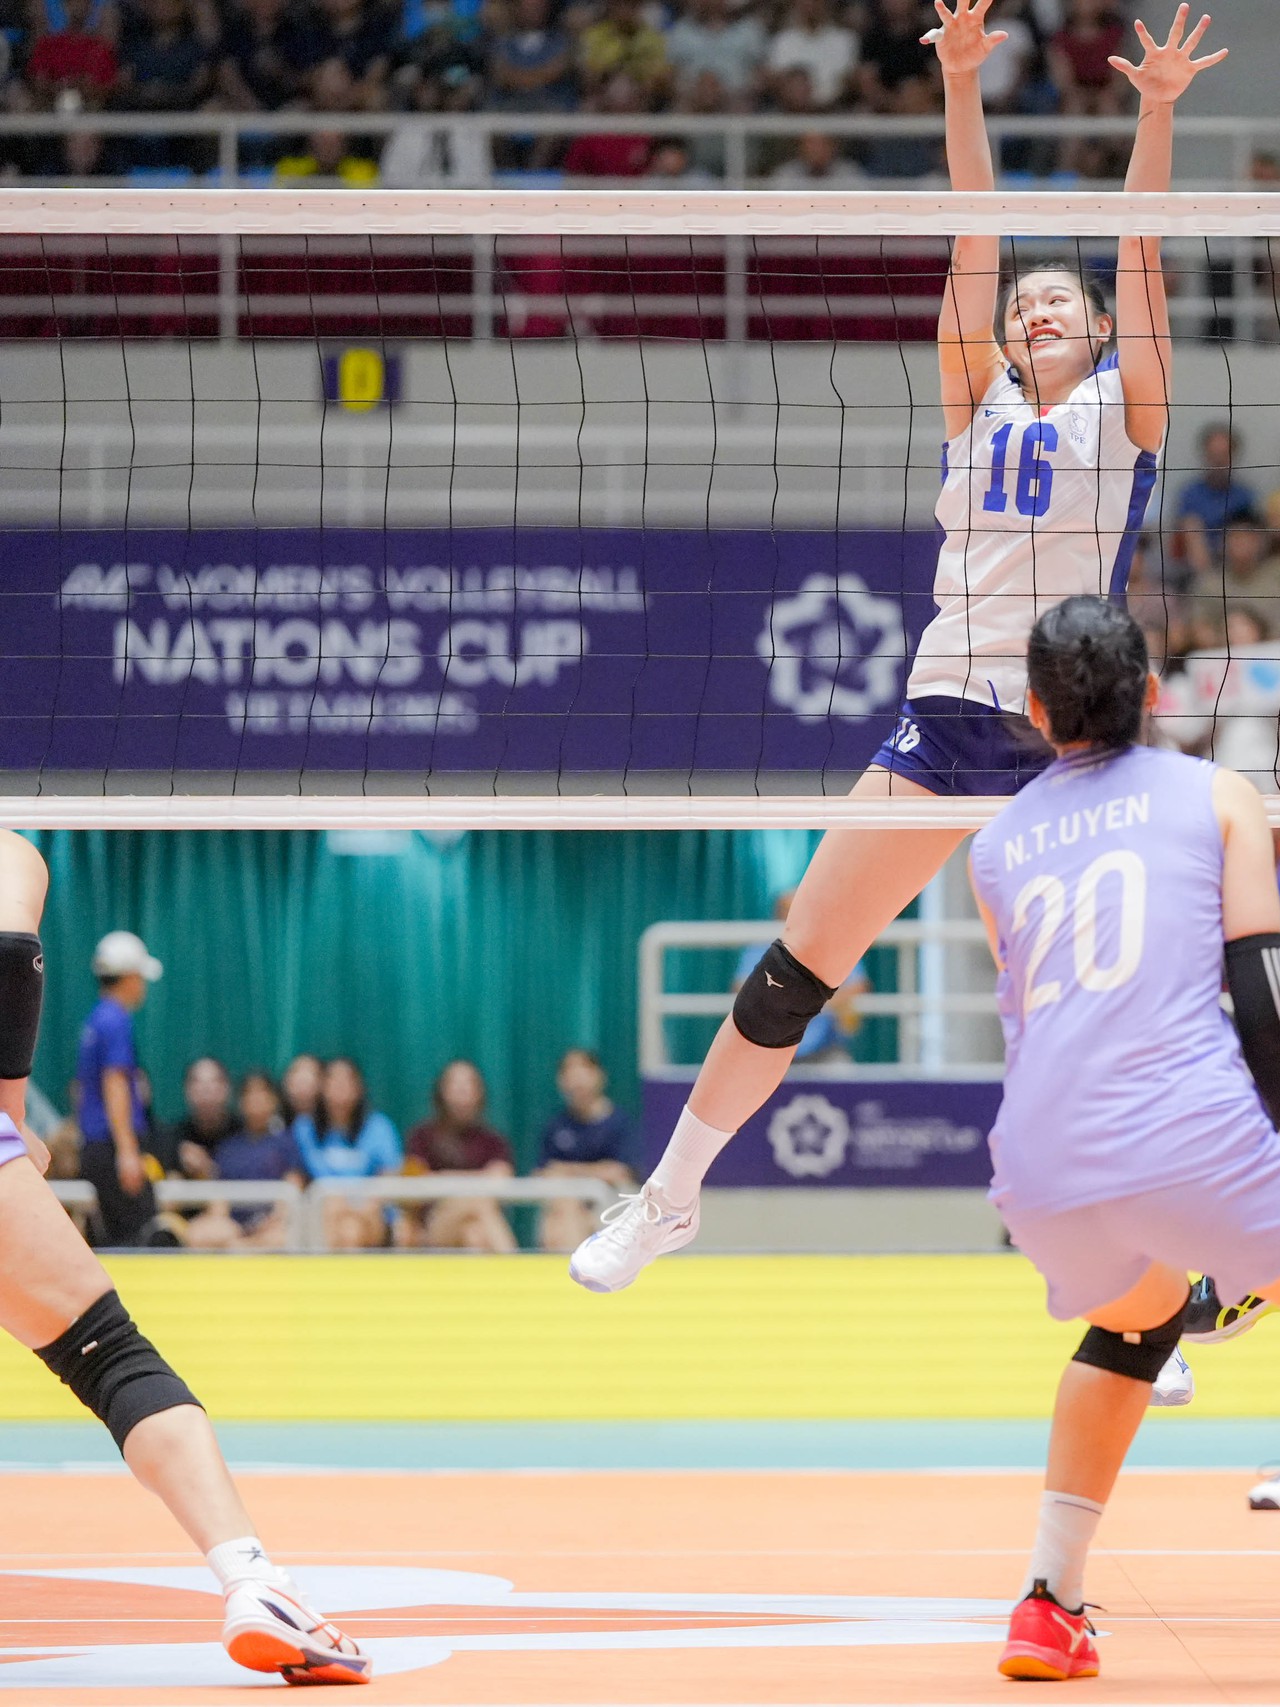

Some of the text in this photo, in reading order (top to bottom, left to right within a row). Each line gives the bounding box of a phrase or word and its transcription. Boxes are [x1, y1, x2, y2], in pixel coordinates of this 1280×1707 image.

[983, 422, 1058, 517] 16
[113, 617, 590, 686] NATIONS CUP
[1004, 792, 1151, 872] N.T.UYEN
[1011, 848, 1147, 1016] 20
